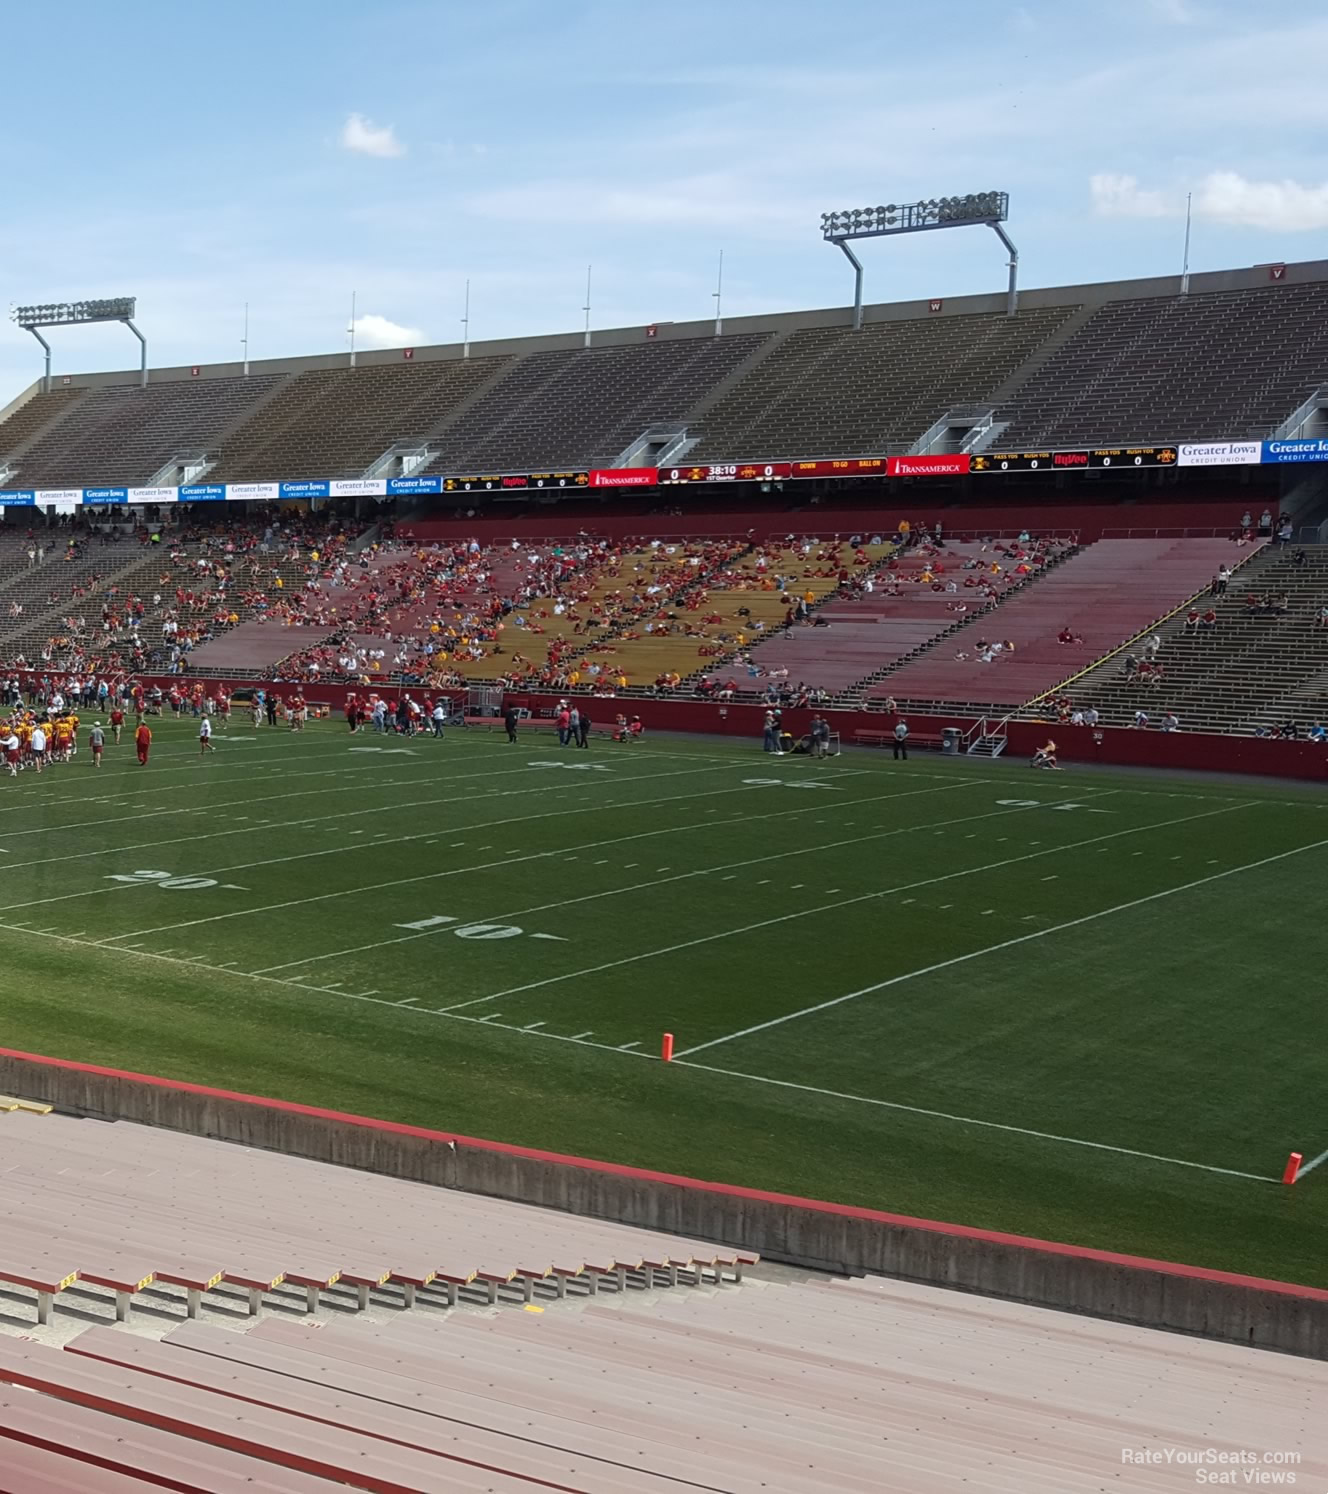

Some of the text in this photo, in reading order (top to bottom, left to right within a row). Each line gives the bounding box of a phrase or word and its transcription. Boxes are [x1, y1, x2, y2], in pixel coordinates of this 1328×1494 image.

[931, 303, 940, 311] W
[1182, 444, 1256, 456] Greater Iowa
[1270, 441, 1328, 453] Greater Io
[1031, 460, 1038, 468] 0
[1103, 457, 1110, 466] 0
[1134, 456, 1142, 465] 0
[708, 465, 736, 475] 38:10
[900, 464, 960, 473] TRANSAMERICA
[1001, 461, 1008, 470] 0
[671, 470, 678, 480] 0
[764, 466, 772, 476] 0
[336, 480, 380, 489] Greater Iowa
[391, 479, 419, 488] Greater
[419, 478, 437, 487] Iowa
[599, 476, 651, 485] TRANSAMERICA
[182, 486, 221, 495] Greater Iowa
[283, 483, 325, 492] Greater Iowa
[17, 492, 31, 500] Iowa
[86, 489, 124, 498] Greater Iowa
[133, 488, 172, 497] Greater Iowa
[103, 870, 219, 889] 20
[392, 915, 524, 939] 10
